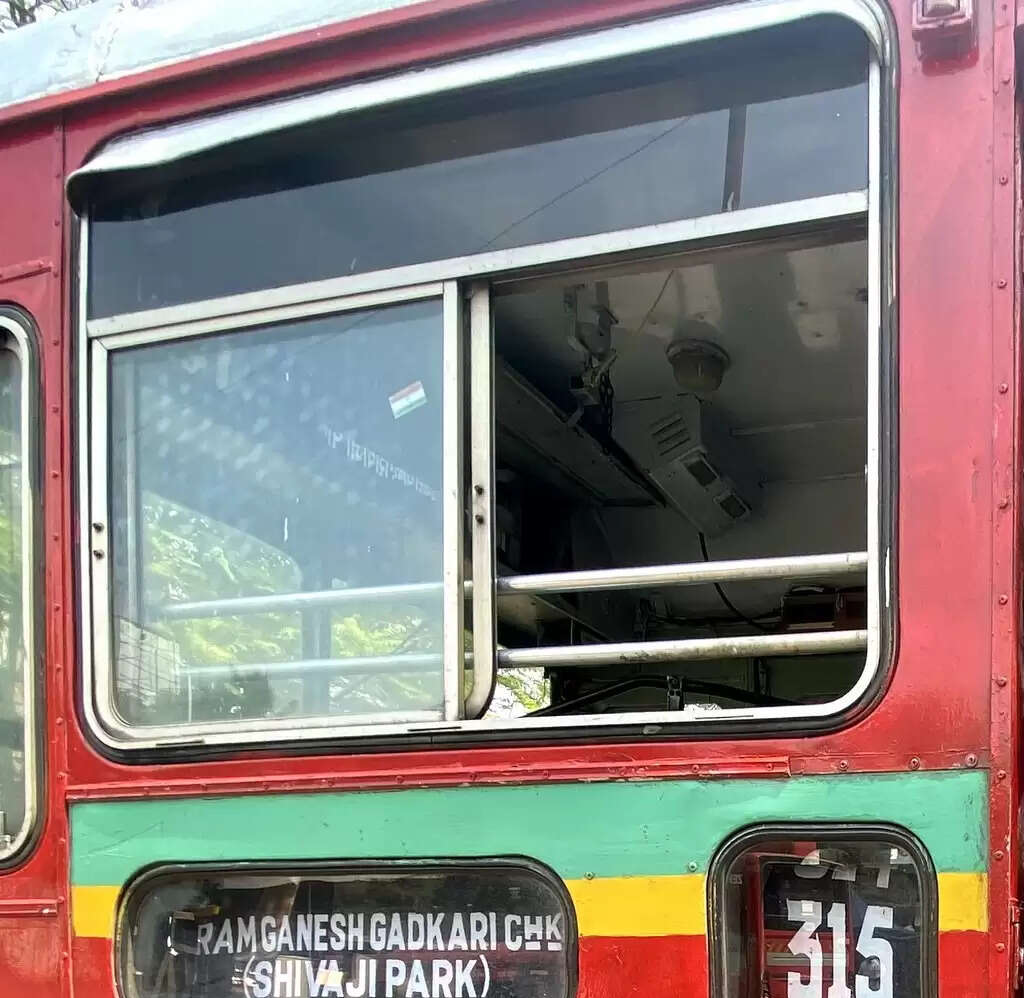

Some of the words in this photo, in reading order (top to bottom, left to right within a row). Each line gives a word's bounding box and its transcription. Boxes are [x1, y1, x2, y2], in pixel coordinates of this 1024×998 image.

[196, 917, 257, 955] RAM
[260, 912, 364, 954] GANESH
[371, 911, 497, 951] GADKARI
